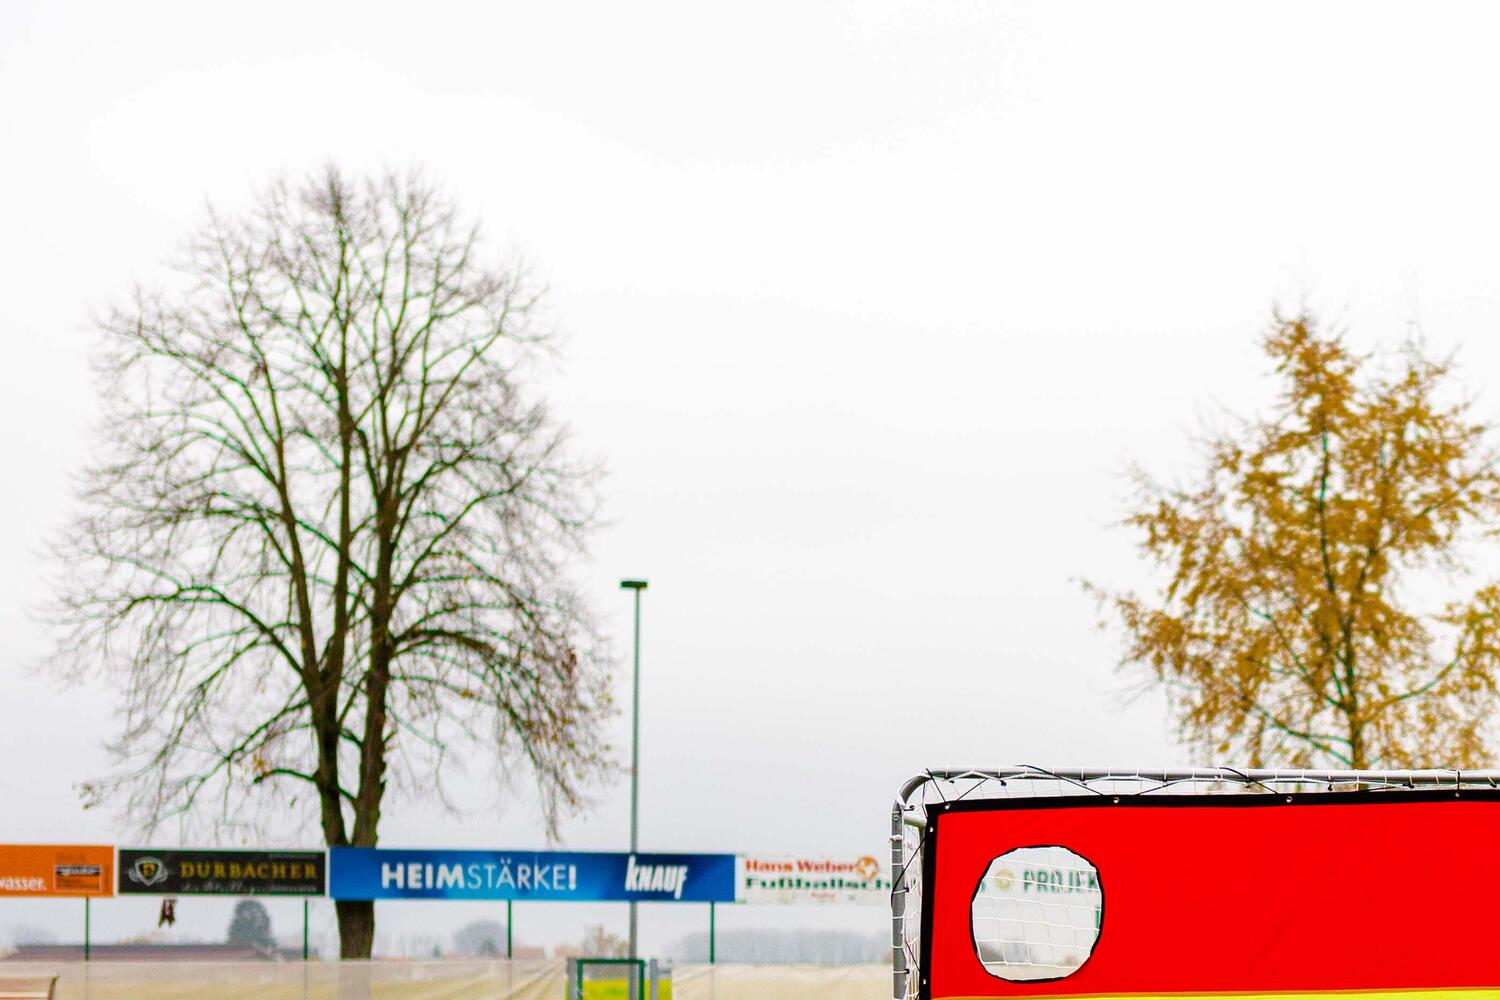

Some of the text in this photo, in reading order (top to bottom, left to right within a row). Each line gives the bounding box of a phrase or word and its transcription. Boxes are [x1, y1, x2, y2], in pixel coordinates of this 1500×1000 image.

[180, 861, 317, 880] DURBACHER
[381, 859, 577, 891] HEIMSTÄRKE!
[746, 860, 856, 872] Hans Weber
[1023, 869, 1099, 893] PROJEK
